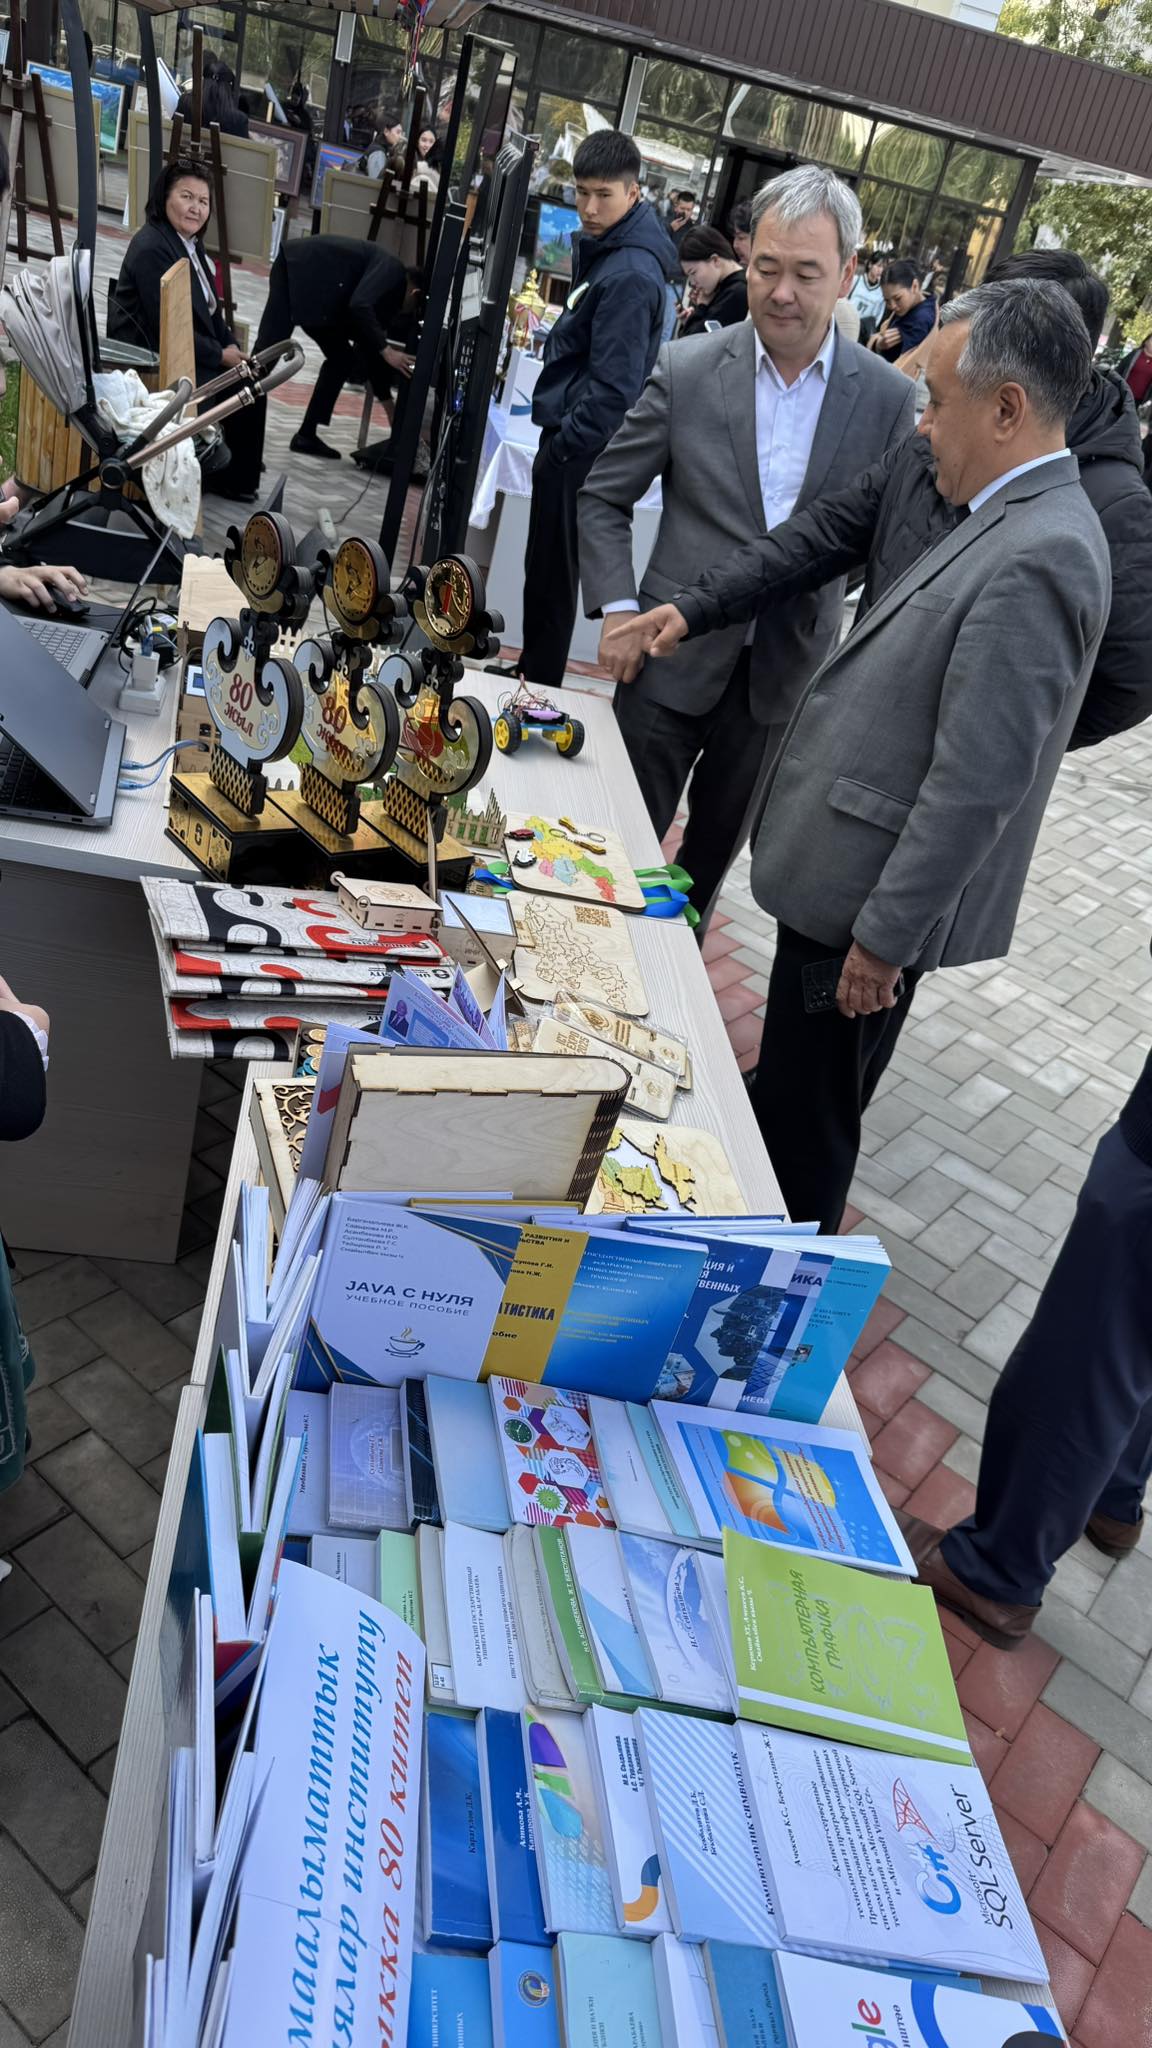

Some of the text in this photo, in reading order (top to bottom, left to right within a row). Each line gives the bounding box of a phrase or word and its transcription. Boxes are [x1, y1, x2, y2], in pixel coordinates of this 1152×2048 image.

[229, 673, 253, 711] 80
[322, 696, 347, 734] 80
[556, 1032, 569, 1047] ICT
[566, 1031, 581, 1051] EXPO
[578, 1037, 590, 1056] 2025
[524, 1232, 563, 1243] РАЗВИТИЯ
[345, 1280, 474, 1307] JAVA С НУЛЯ
[726, 1263, 735, 1273] И
[346, 1294, 470, 1316] УЧЕБНОЕ ПОСОБИЕ
[789, 1568, 826, 1695] КОМПЬЮТЕРНАЯ
[816, 1599, 843, 1670] ГРАФИКА
[343, 1610, 386, 1894] институту
[389, 1650, 413, 1816] китеп
[768, 1750, 787, 1805] Бексултанов
[853, 1787, 866, 1808] SQL
[822, 1748, 879, 1926] Проектирование информационных
[830, 1748, 892, 1931] систем на основе клиент серверной
[860, 1808, 880, 1857] «Microsoft
[869, 1806, 884, 1834] Visual
[376, 1817, 405, 1891] 80
[878, 1834, 899, 1887] «Microsoft
[904, 1842, 962, 1915] C#
[951, 1785, 1014, 1930] SQL Server
[969, 1870, 992, 1926] Microsoft
